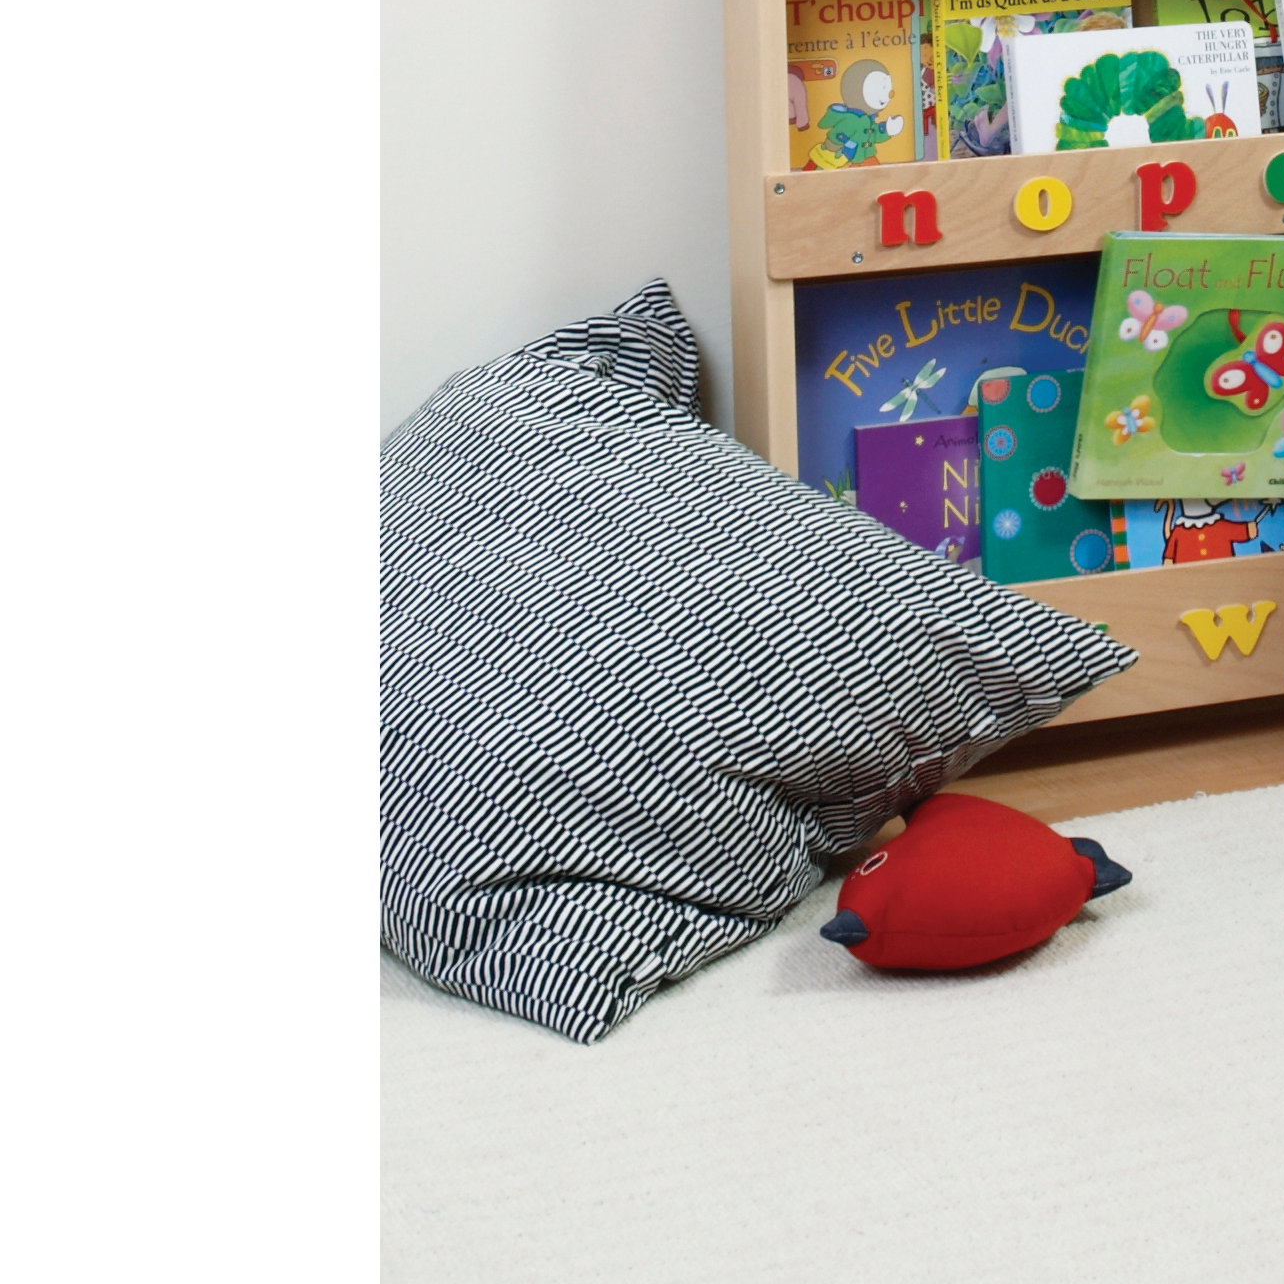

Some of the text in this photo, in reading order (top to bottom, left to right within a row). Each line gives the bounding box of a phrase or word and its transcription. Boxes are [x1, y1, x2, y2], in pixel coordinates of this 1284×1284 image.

[787, 29, 917, 54] rentre à l'école
[1195, 27, 1247, 41] THE VERY
[1204, 39, 1248, 52] HUNGRY
[1177, 50, 1249, 65] CATERPILLAR
[876, 189, 943, 248] n
[1014, 175, 1073, 232] o
[1135, 160, 1197, 232] p
[1121, 252, 1212, 290] Float
[824, 281, 1090, 397] Five Little Duc
[1179, 600, 1277, 661] w
